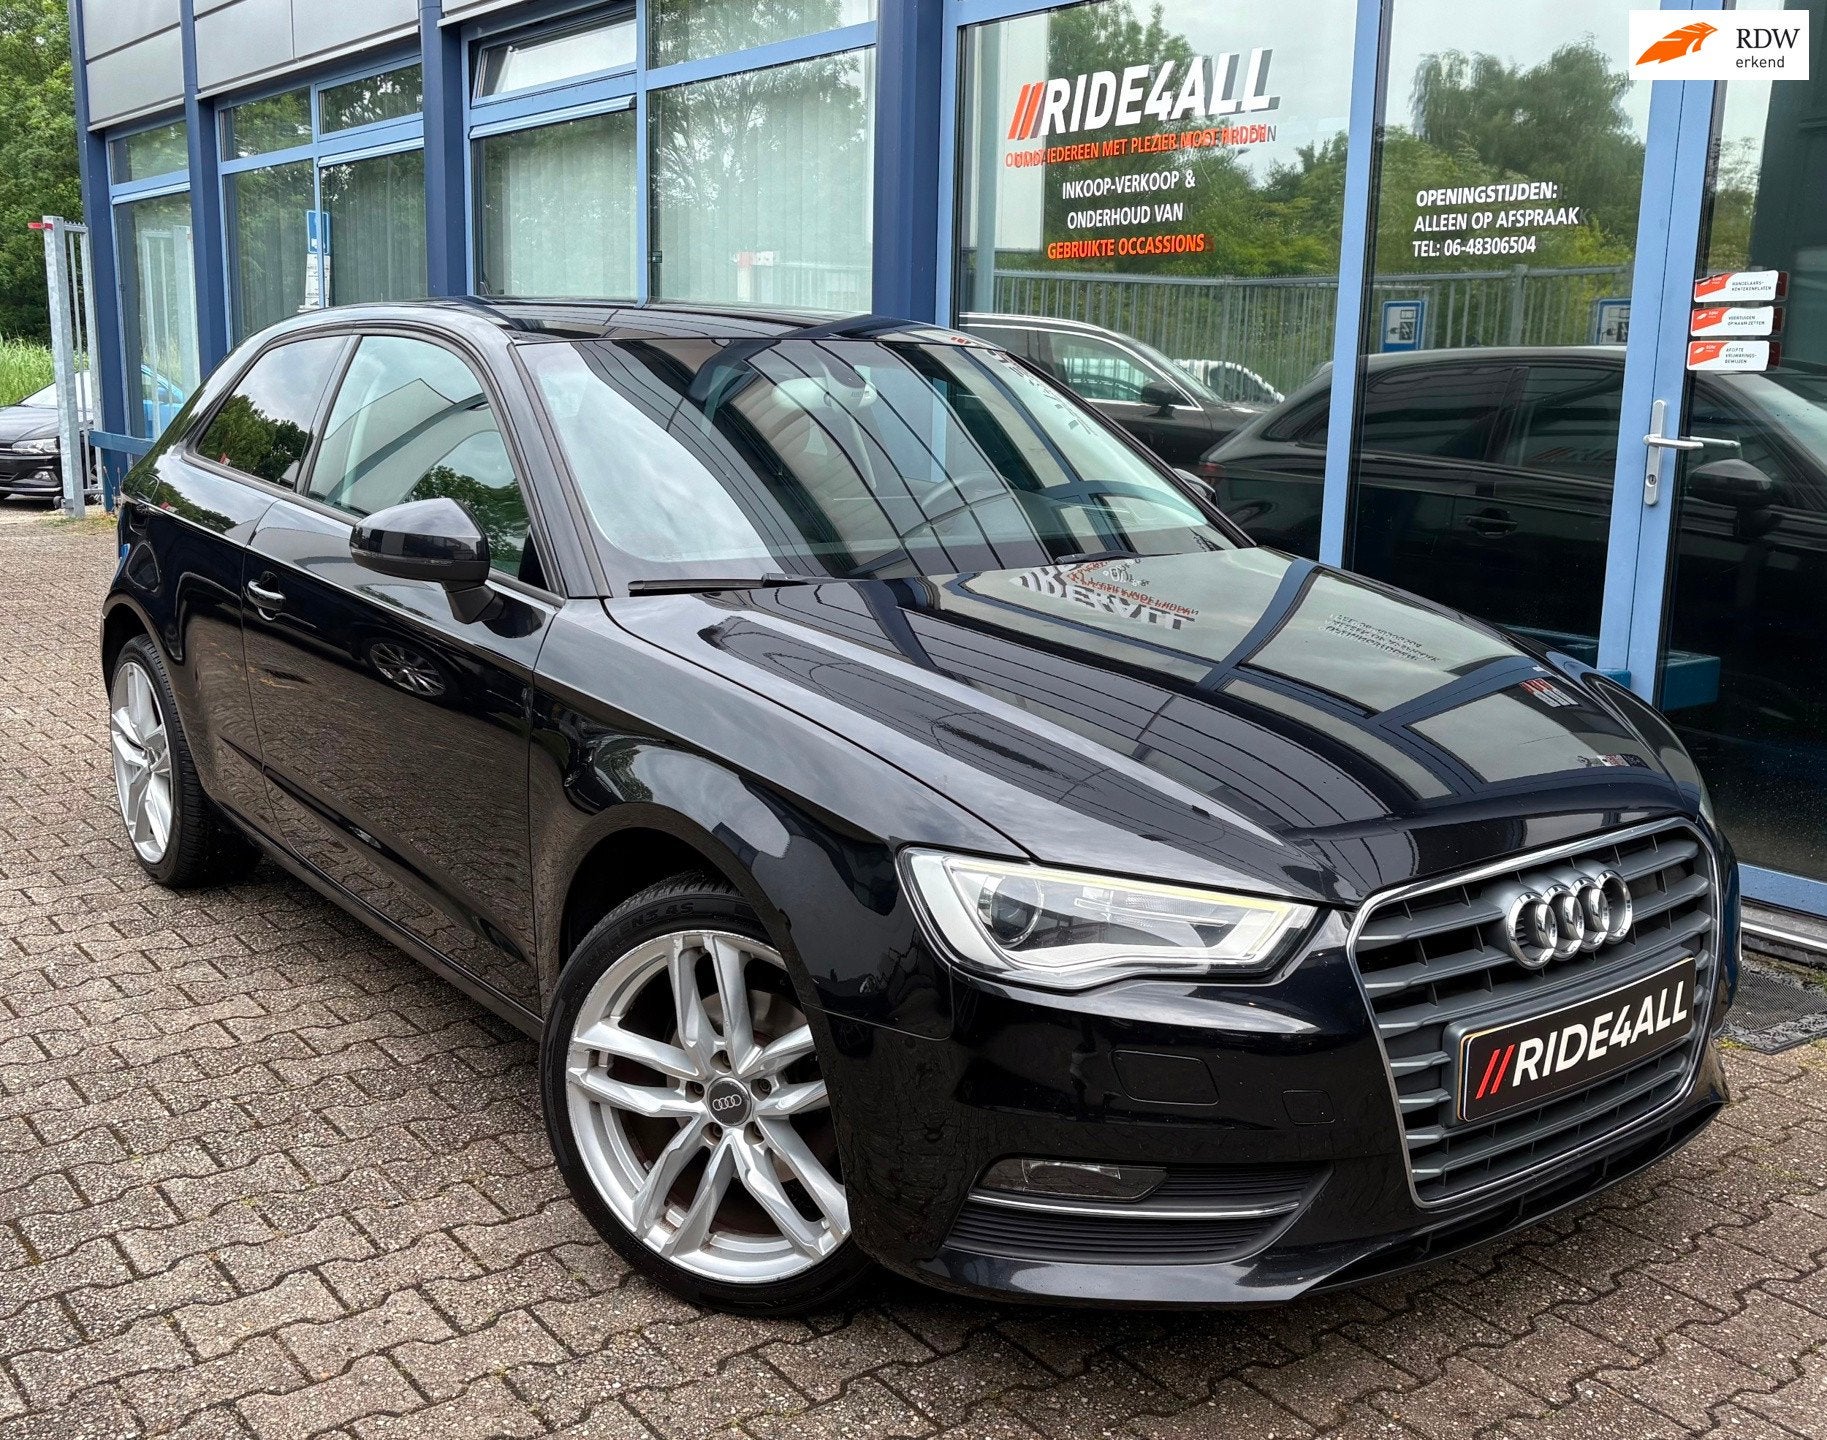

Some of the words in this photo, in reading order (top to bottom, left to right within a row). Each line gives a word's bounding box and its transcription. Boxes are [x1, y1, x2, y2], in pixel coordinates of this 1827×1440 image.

[1041, 47, 1277, 136] RIDE4ALL
[1047, 142, 1099, 164] IEDEREEN
[1102, 138, 1128, 156] MET
[1131, 133, 1176, 153] PLEZIER
[1062, 170, 1180, 200] INKOOP-VERKOOP
[1185, 169, 1196, 189] &
[1415, 181, 1558, 207] OPENINGSTIJDEN:
[1067, 205, 1151, 229] ONDERHOUD
[1154, 202, 1184, 222] VAN
[1413, 212, 1467, 232] ALLEEN
[1471, 211, 1493, 229] OP
[1495, 206, 1580, 228] AFSPRAAK
[1047, 238, 1115, 260] GEBRUIKTE
[1118, 233, 1205, 256] OCCASSIONS
[1412, 240, 1440, 258] TEL:
[1444, 235, 1537, 257] 06-48306504
[1512, 980, 1687, 1087] RIDE4ALL
